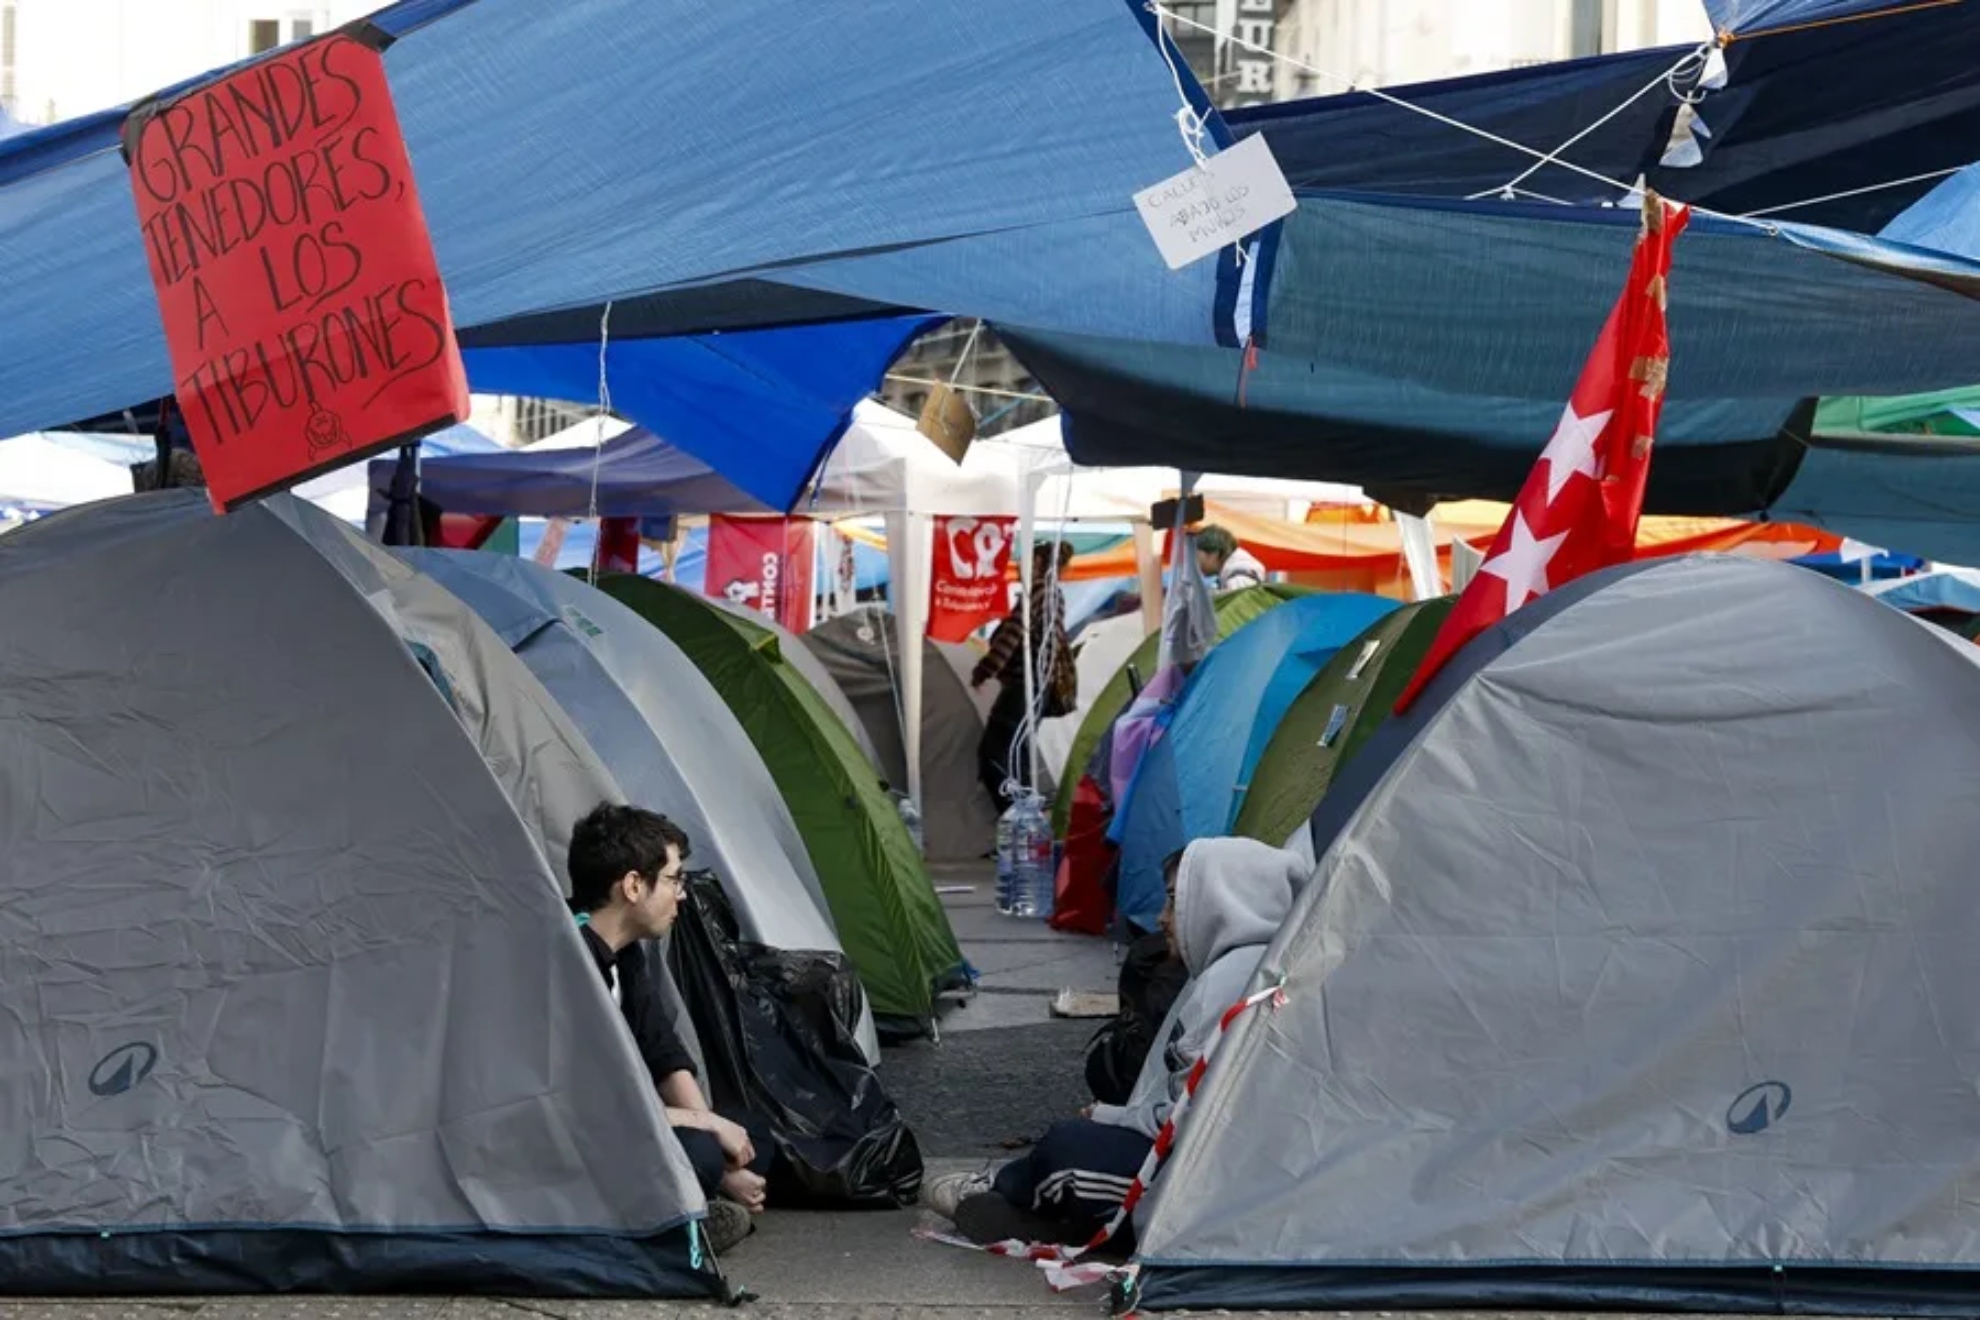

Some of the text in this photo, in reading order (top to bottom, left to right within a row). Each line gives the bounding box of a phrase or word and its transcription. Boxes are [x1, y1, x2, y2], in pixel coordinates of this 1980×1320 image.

[136, 36, 362, 202] GRANDES
[142, 126, 405, 286] TENEDORES,
[196, 221, 362, 350] A LOS
[182, 278, 447, 445] TIBURONES
